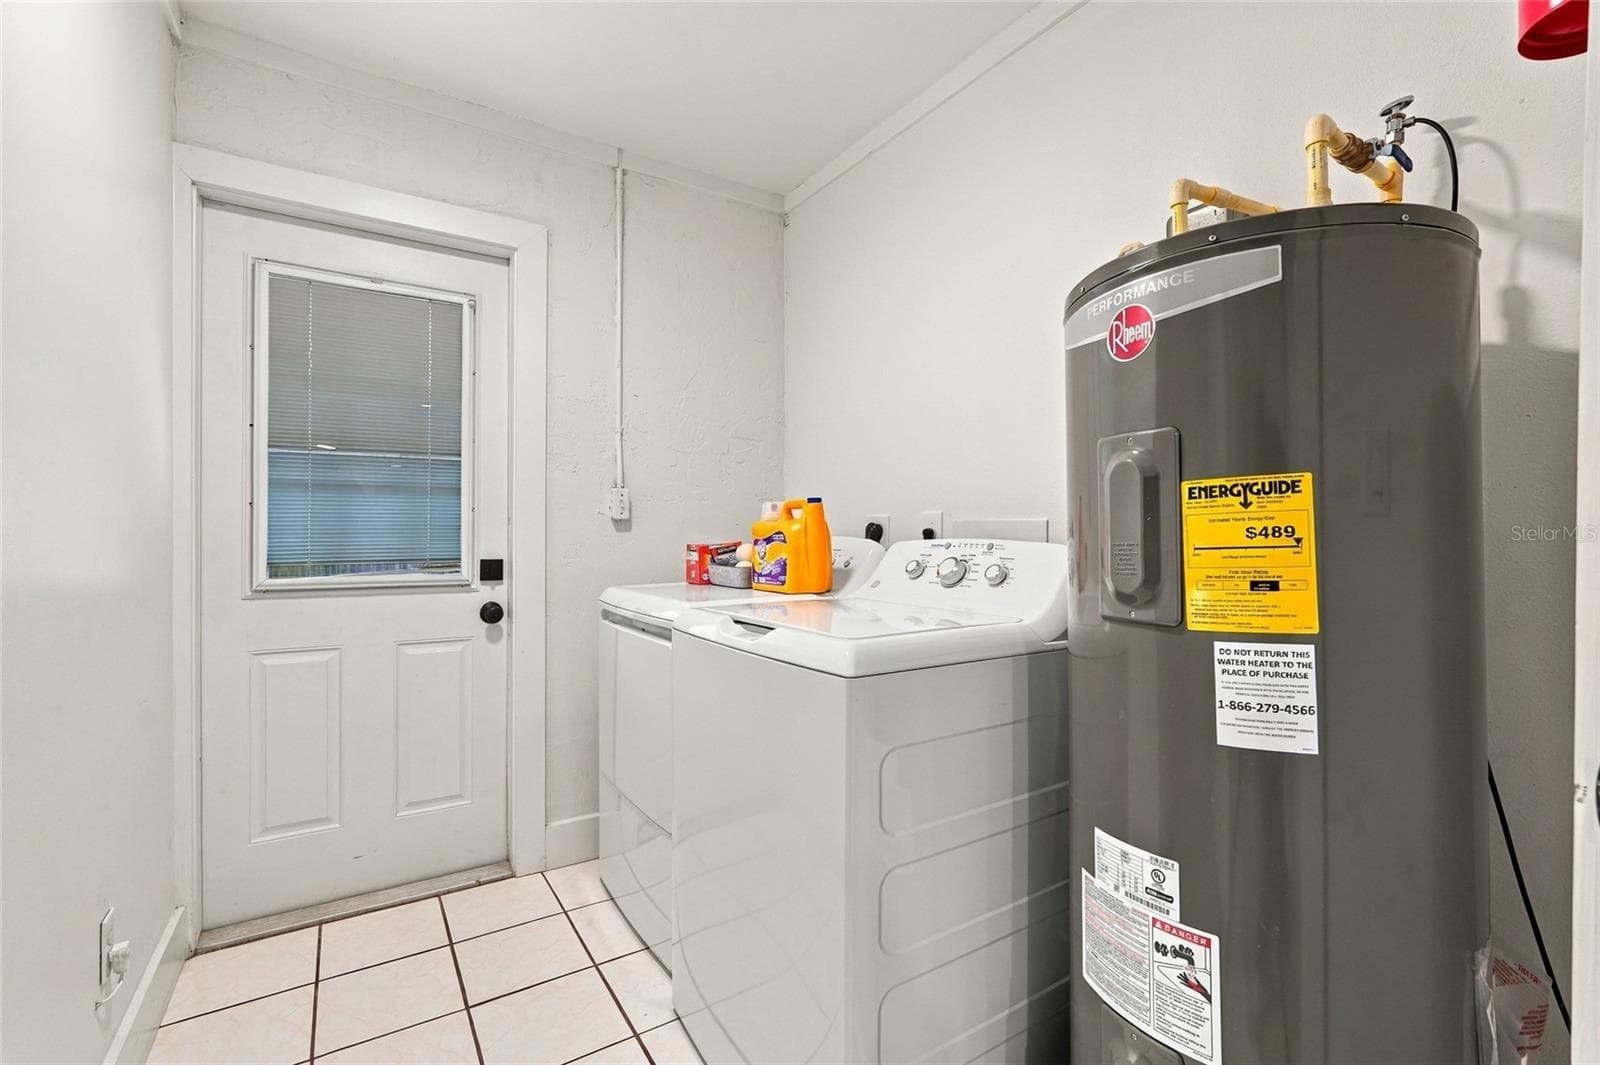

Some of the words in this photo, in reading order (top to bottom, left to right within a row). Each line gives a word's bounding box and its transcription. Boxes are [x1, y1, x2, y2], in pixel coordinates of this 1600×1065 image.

[1087, 269, 1195, 320] PERFORMANCE
[1112, 309, 1151, 354] Rheem
[1245, 525, 1296, 540] $489
[1219, 648, 1232, 656] DO
[1254, 650, 1289, 658] RETURN
[1291, 651, 1311, 659] THIS
[1217, 658, 1246, 666] WATER
[1248, 659, 1280, 668] HEATER
[1282, 661, 1294, 669] TO
[1296, 662, 1313, 670] THE
[1221, 668, 1248, 677] PLACE
[1249, 670, 1260, 678] OF
[1262, 671, 1309, 680] PURCHASE
[1218, 700, 1316, 716] 1-866-279-4566
[1164, 924, 1207, 946] DANGER
